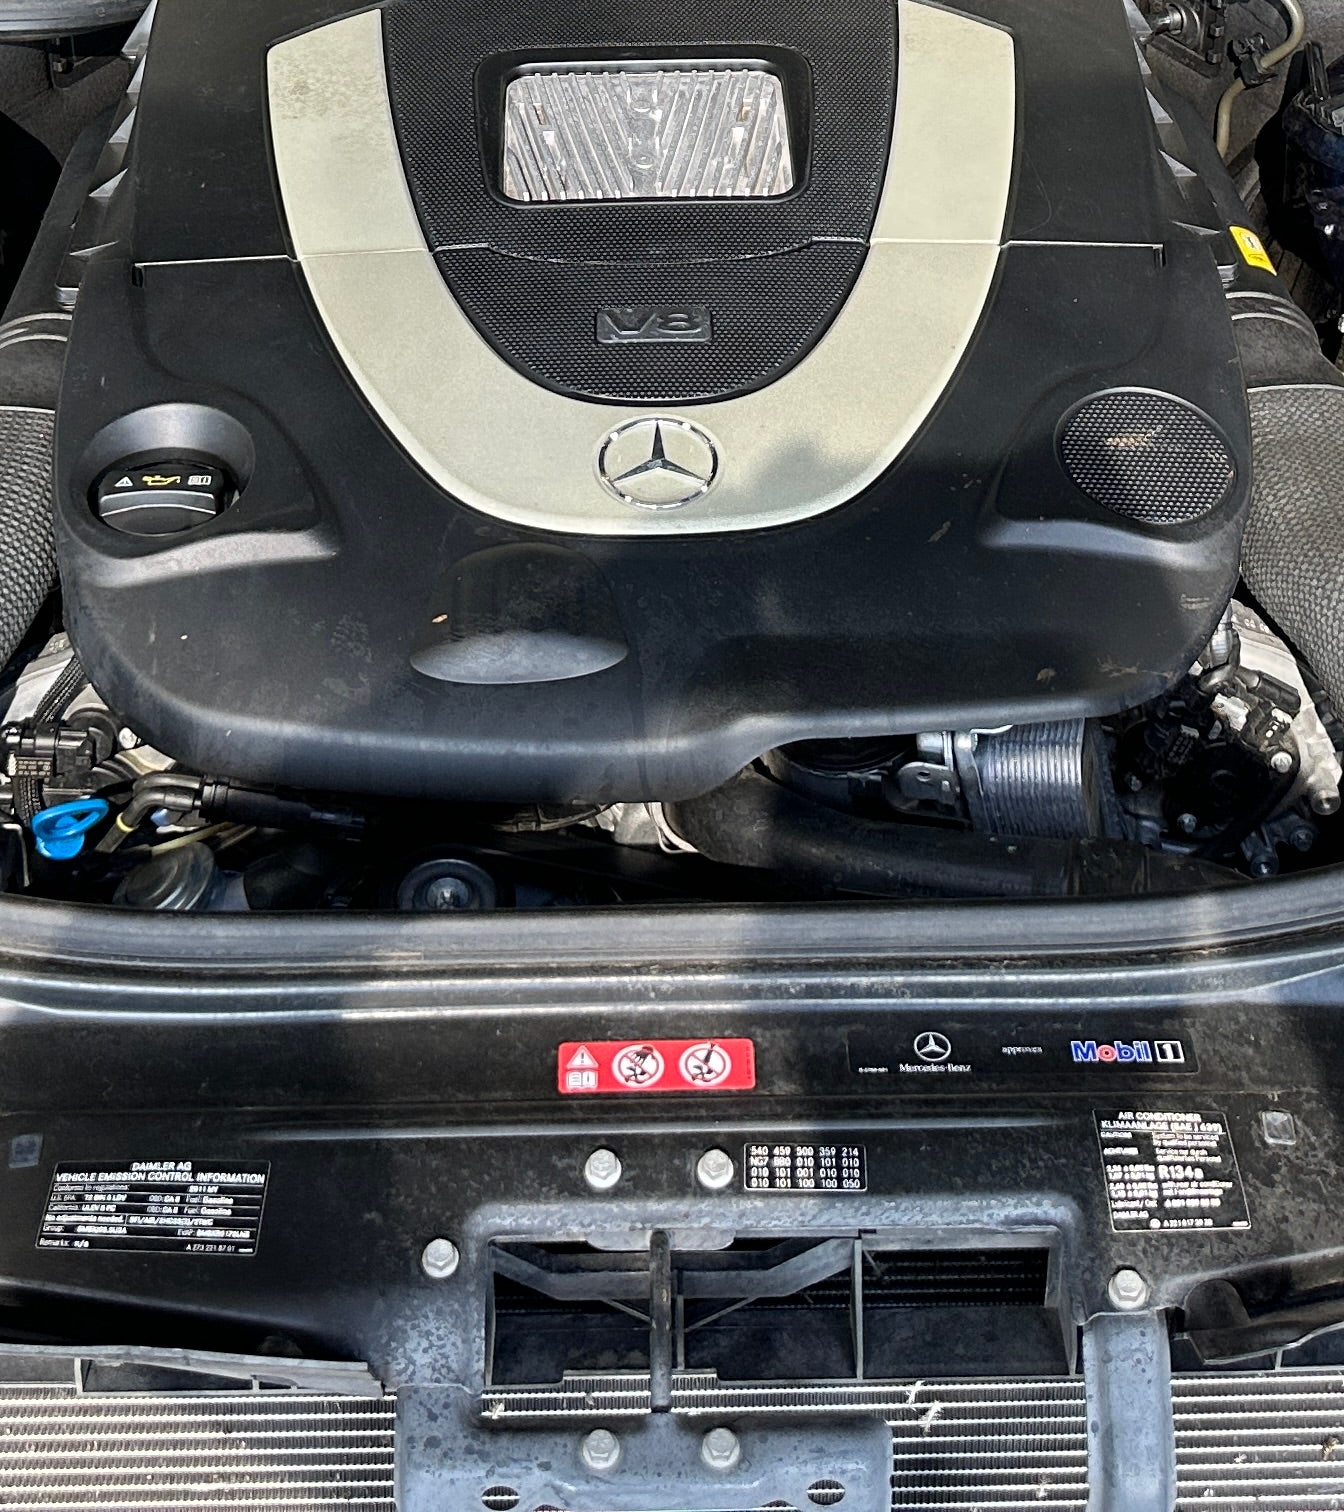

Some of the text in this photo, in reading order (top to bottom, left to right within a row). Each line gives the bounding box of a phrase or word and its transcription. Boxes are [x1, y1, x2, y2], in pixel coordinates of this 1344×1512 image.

[602, 308, 703, 335] V8
[1069, 1040, 1152, 1063] Mobil
[899, 1063, 971, 1072] Mercedes-Benz
[1118, 1111, 1201, 1122] AIR CONDITIONER
[1101, 1120, 1169, 1130] KLIMAANLAGE
[750, 1145, 858, 1157] 540 459 500 359 214
[132, 1161, 192, 1171] DAIMLER AG
[749, 1157, 768, 1167] NG7
[796, 1157, 814, 1167] 010
[821, 1158, 836, 1168] 101
[842, 1158, 859, 1168] 010
[56, 1171, 265, 1183] VEHICLE EMISSION CONTROL INFORMATION
[751, 1168, 860, 1179] 010 101 001 010 010
[1158, 1164, 1204, 1180] R134a
[751, 1178, 860, 1189] 010 101 100 100 050
